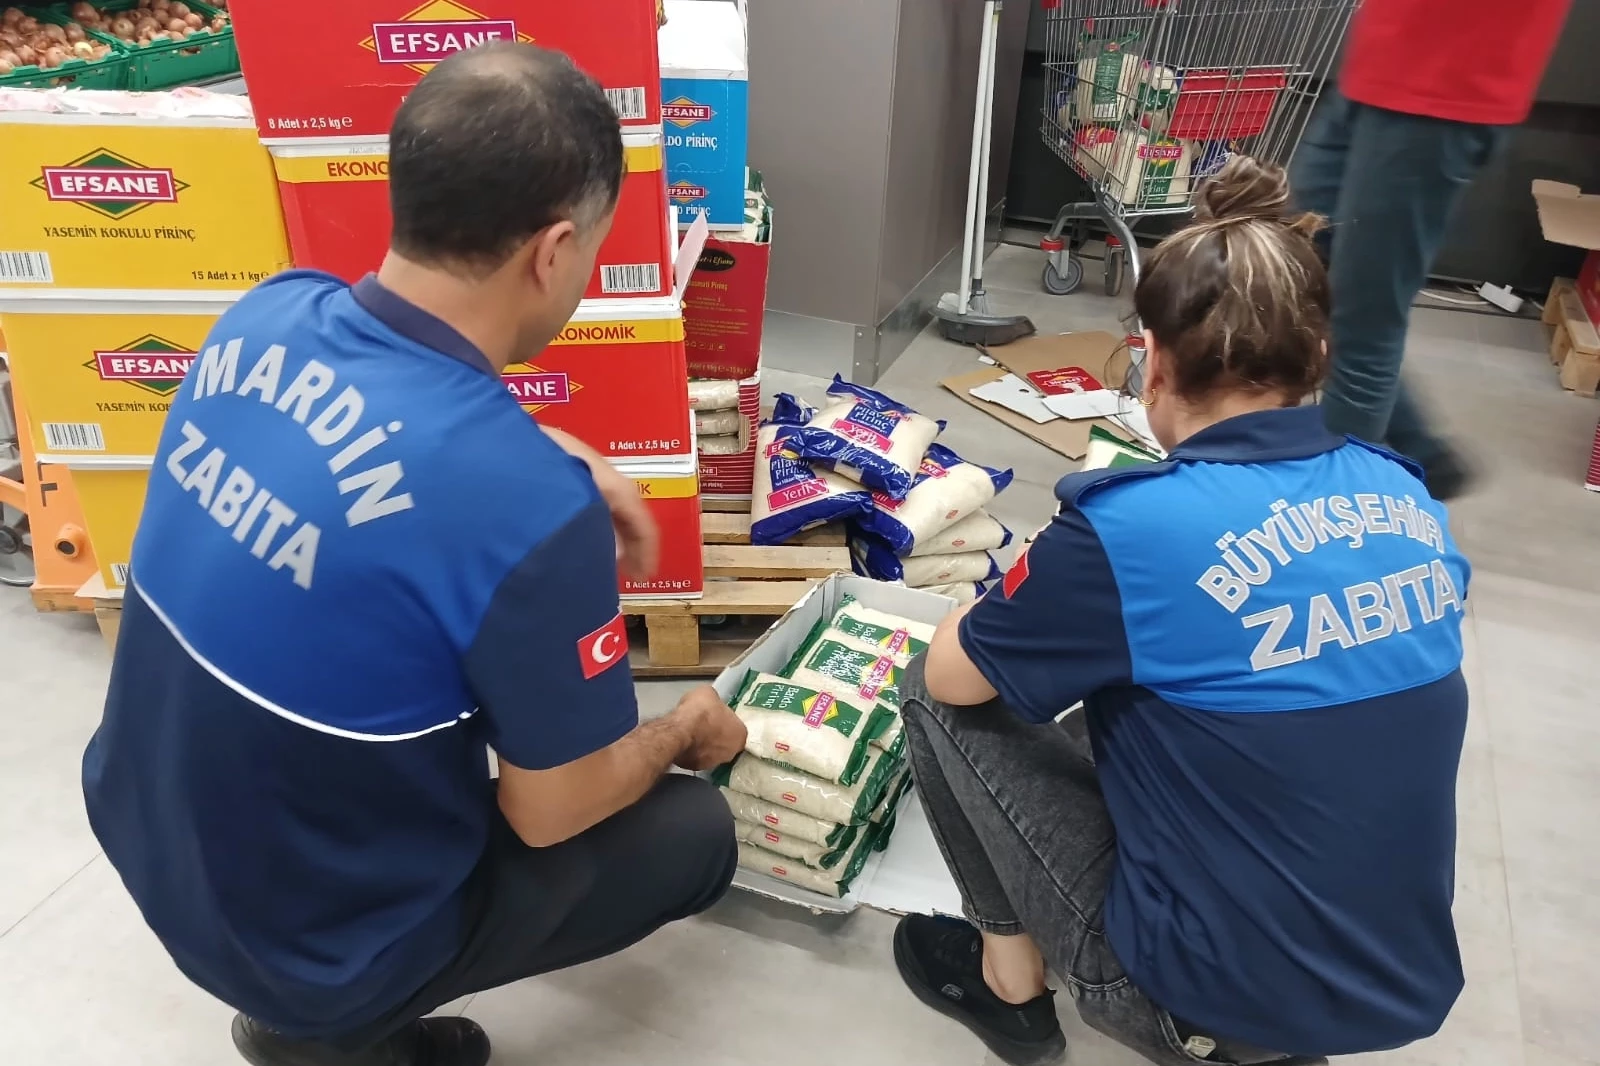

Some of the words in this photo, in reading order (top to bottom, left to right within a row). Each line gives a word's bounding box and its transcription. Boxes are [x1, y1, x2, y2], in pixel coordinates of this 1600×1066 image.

[662, 107, 705, 117] EFSANE
[268, 117, 276, 129] 8
[278, 117, 301, 129] Adet
[302, 119, 309, 129] x
[310, 116, 327, 130] 2,5
[685, 132, 718, 151] PİRİNÇ
[327, 160, 390, 177] EKONO
[60, 175, 160, 194] EFSANE
[667, 188, 701, 196] EFSANE
[44, 225, 97, 238] YASEMİN
[100, 227, 151, 239] KOKULU
[154, 225, 196, 242] PİRİNÇ
[191, 270, 204, 280] 15
[207, 270, 229, 281] Adet
[231, 272, 238, 280] x
[240, 271, 245, 280] 1
[553, 323, 636, 341] ONOMİK
[111, 358, 194, 374] EFSAN
[507, 381, 557, 396] ANE
[96, 401, 146, 412] YASEMİN
[193, 337, 415, 527] MARDİN
[609, 441, 616, 450] 8
[618, 441, 637, 450] Adet
[638, 442, 643, 450] x
[645, 440, 658, 451] 2,5
[166, 420, 321, 591] ZABITA
[1196, 493, 1445, 613] BÜYÜKŞEHİR
[625, 581, 631, 589] 8
[658, 580, 671, 590] 2,5
[1241, 559, 1461, 672] ZABITA
[886, 632, 905, 655] EFSA
[778, 686, 800, 708] Baldo
[809, 693, 831, 722] EFSANE
